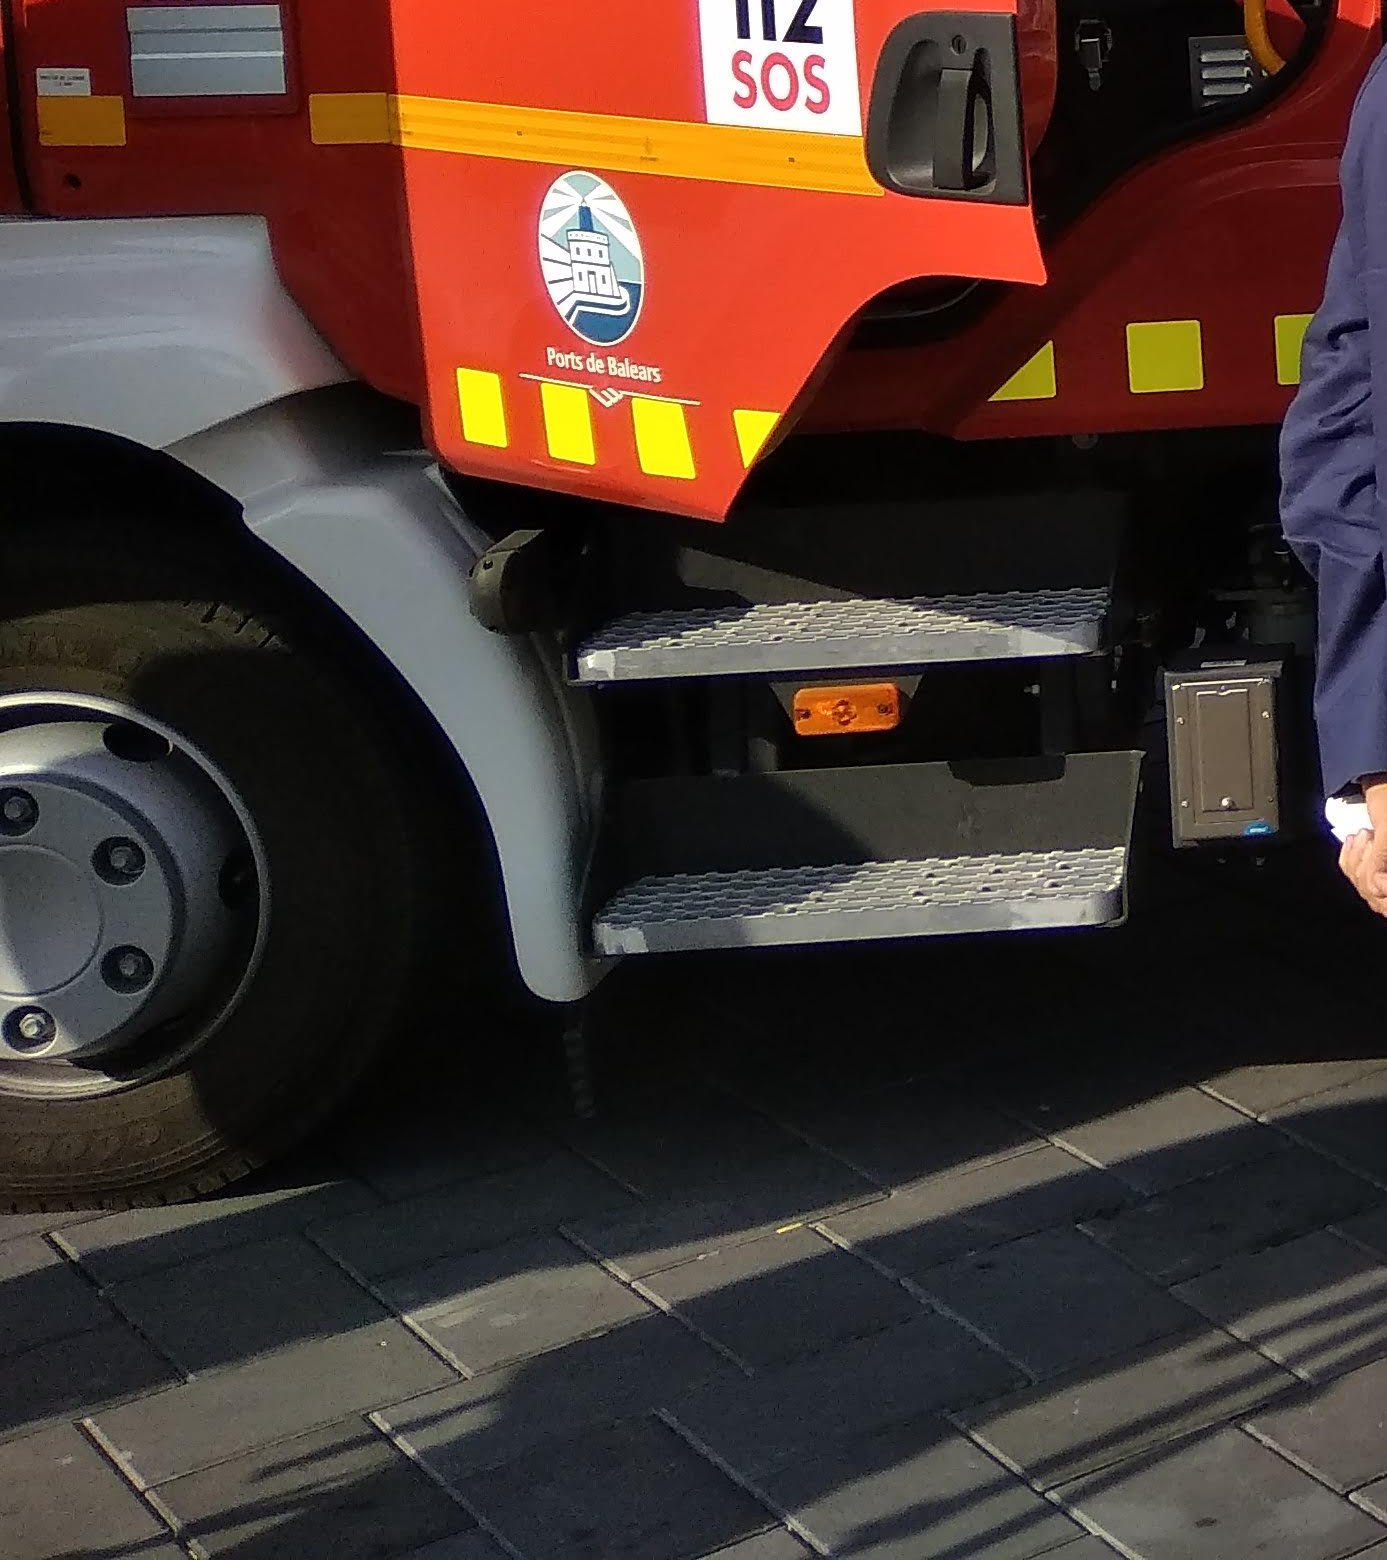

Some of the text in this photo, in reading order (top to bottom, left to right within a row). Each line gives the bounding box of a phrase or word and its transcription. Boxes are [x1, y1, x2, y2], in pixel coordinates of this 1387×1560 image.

[732, 50, 831, 114] SOS
[546, 347, 662, 383] Ports de Balears
